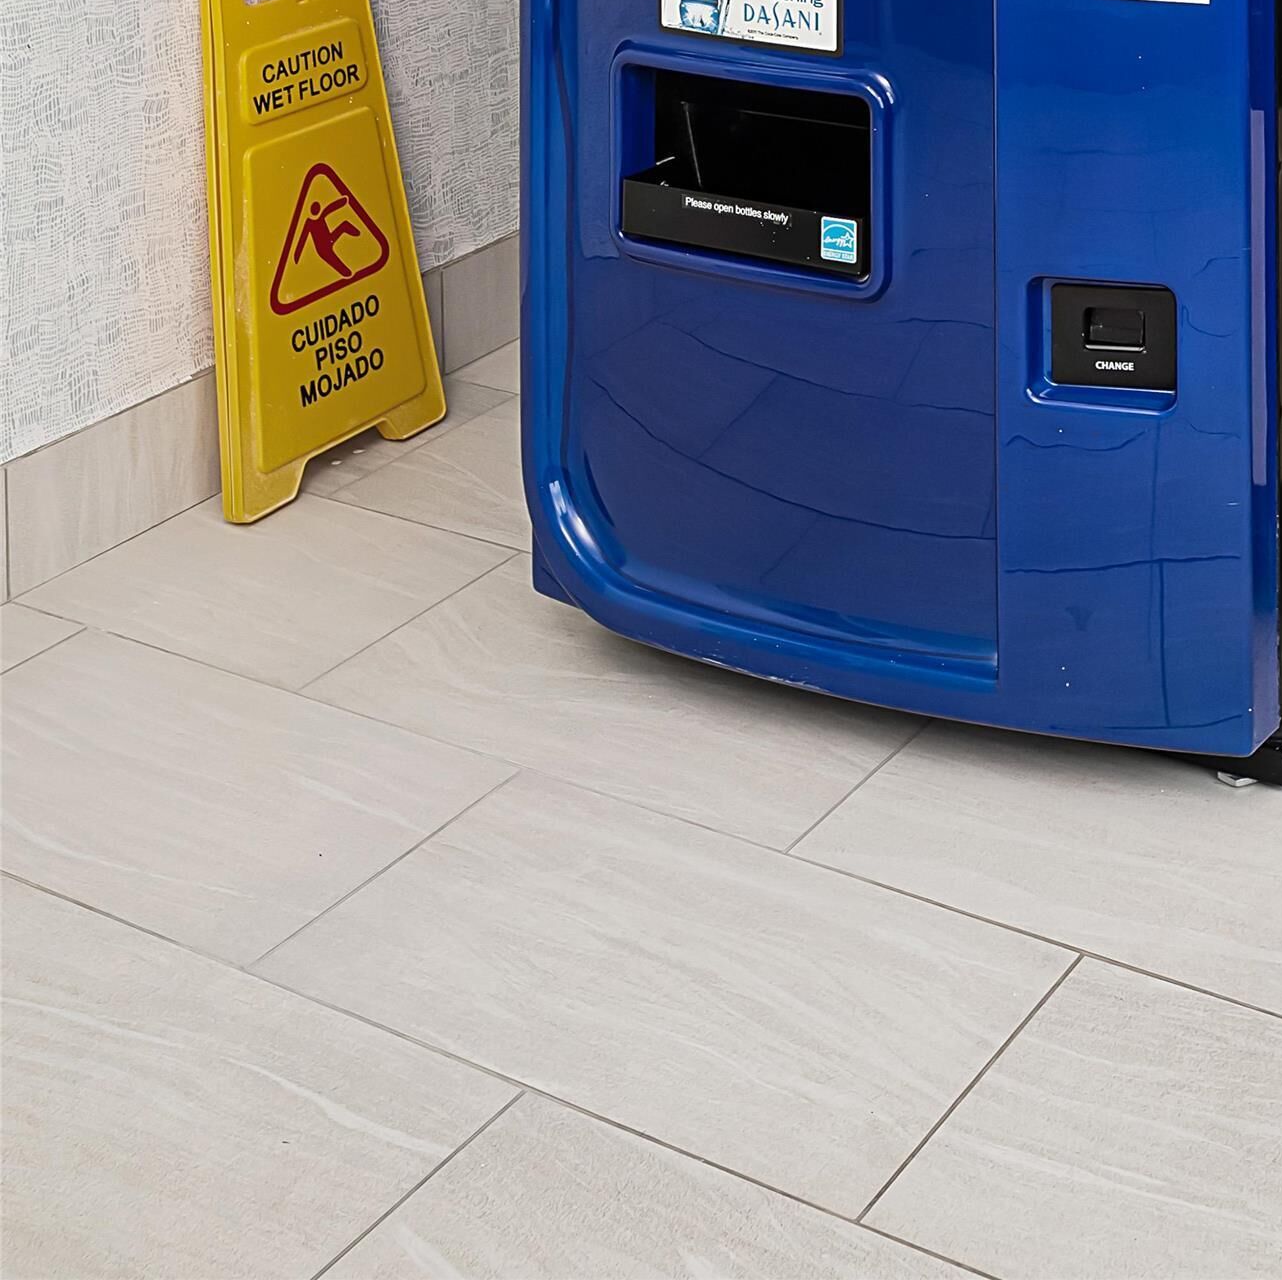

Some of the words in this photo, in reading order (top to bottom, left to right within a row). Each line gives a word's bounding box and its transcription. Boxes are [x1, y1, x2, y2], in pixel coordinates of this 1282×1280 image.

[744, 1, 820, 32] DASANI
[262, 40, 343, 83] CAUTION
[253, 84, 294, 115] WET
[298, 64, 360, 100] FLOOR
[685, 196, 712, 210] Please
[713, 203, 734, 214] open
[735, 204, 762, 219] bottles
[763, 209, 789, 225] slowly
[291, 295, 380, 353] CUIDADO
[315, 330, 362, 371] PISO
[1095, 360, 1135, 371] CHANGE
[300, 348, 384, 407] MOJADO
